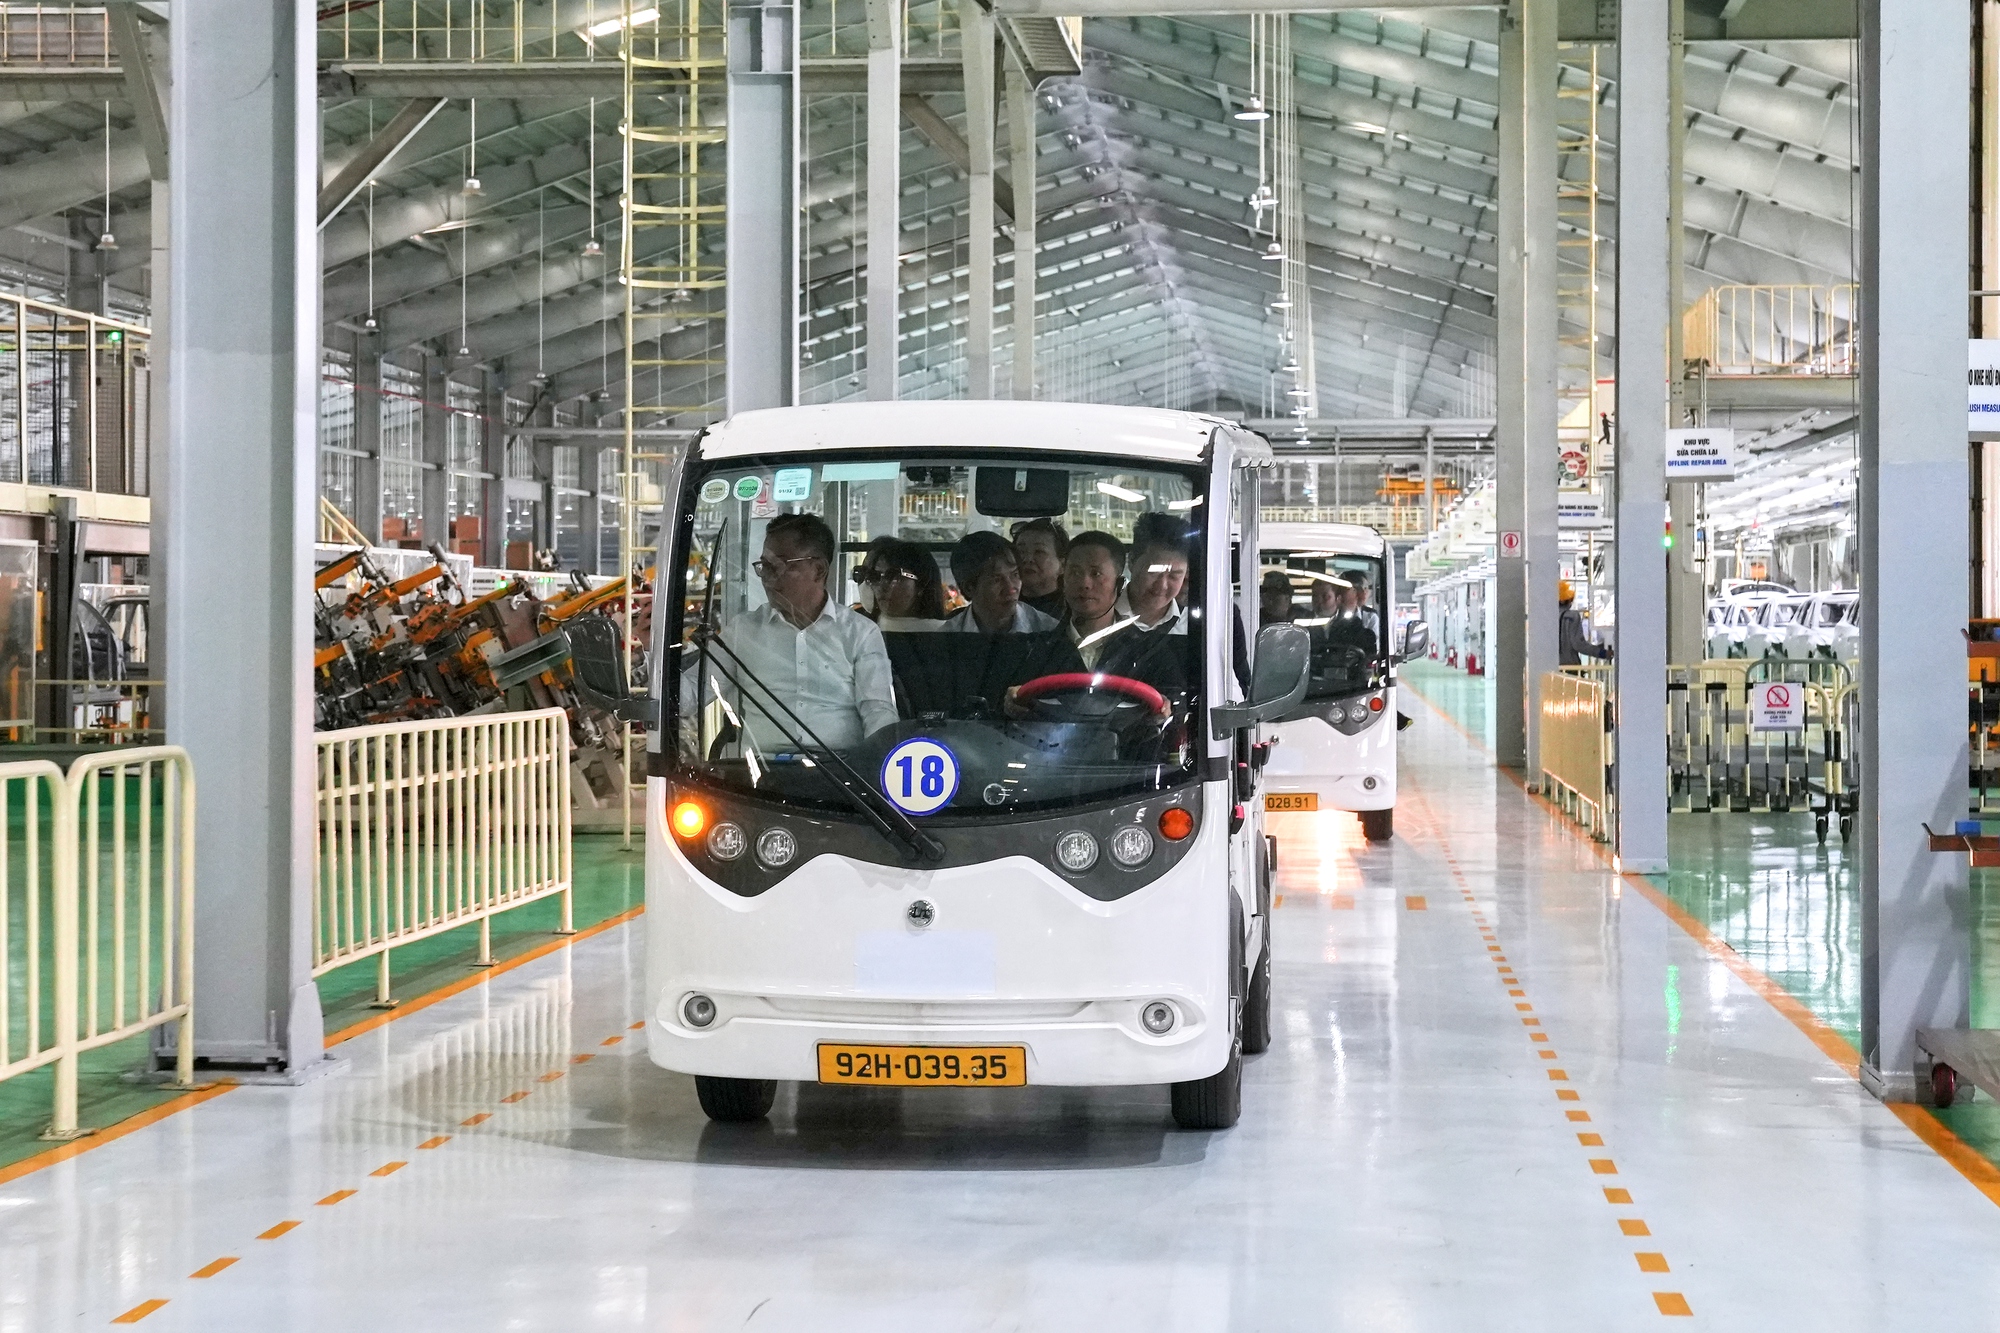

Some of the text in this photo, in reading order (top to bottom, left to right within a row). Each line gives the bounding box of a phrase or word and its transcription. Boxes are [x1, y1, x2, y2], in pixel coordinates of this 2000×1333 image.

[1698, 438, 1710, 446] VỰC
[1676, 448, 1689, 456] SỬA
[1690, 448, 1707, 456] CHỮA
[896, 755, 944, 798] 18
[1267, 797, 1309, 809] 028.91
[836, 1052, 1007, 1080] 92H-039.35
